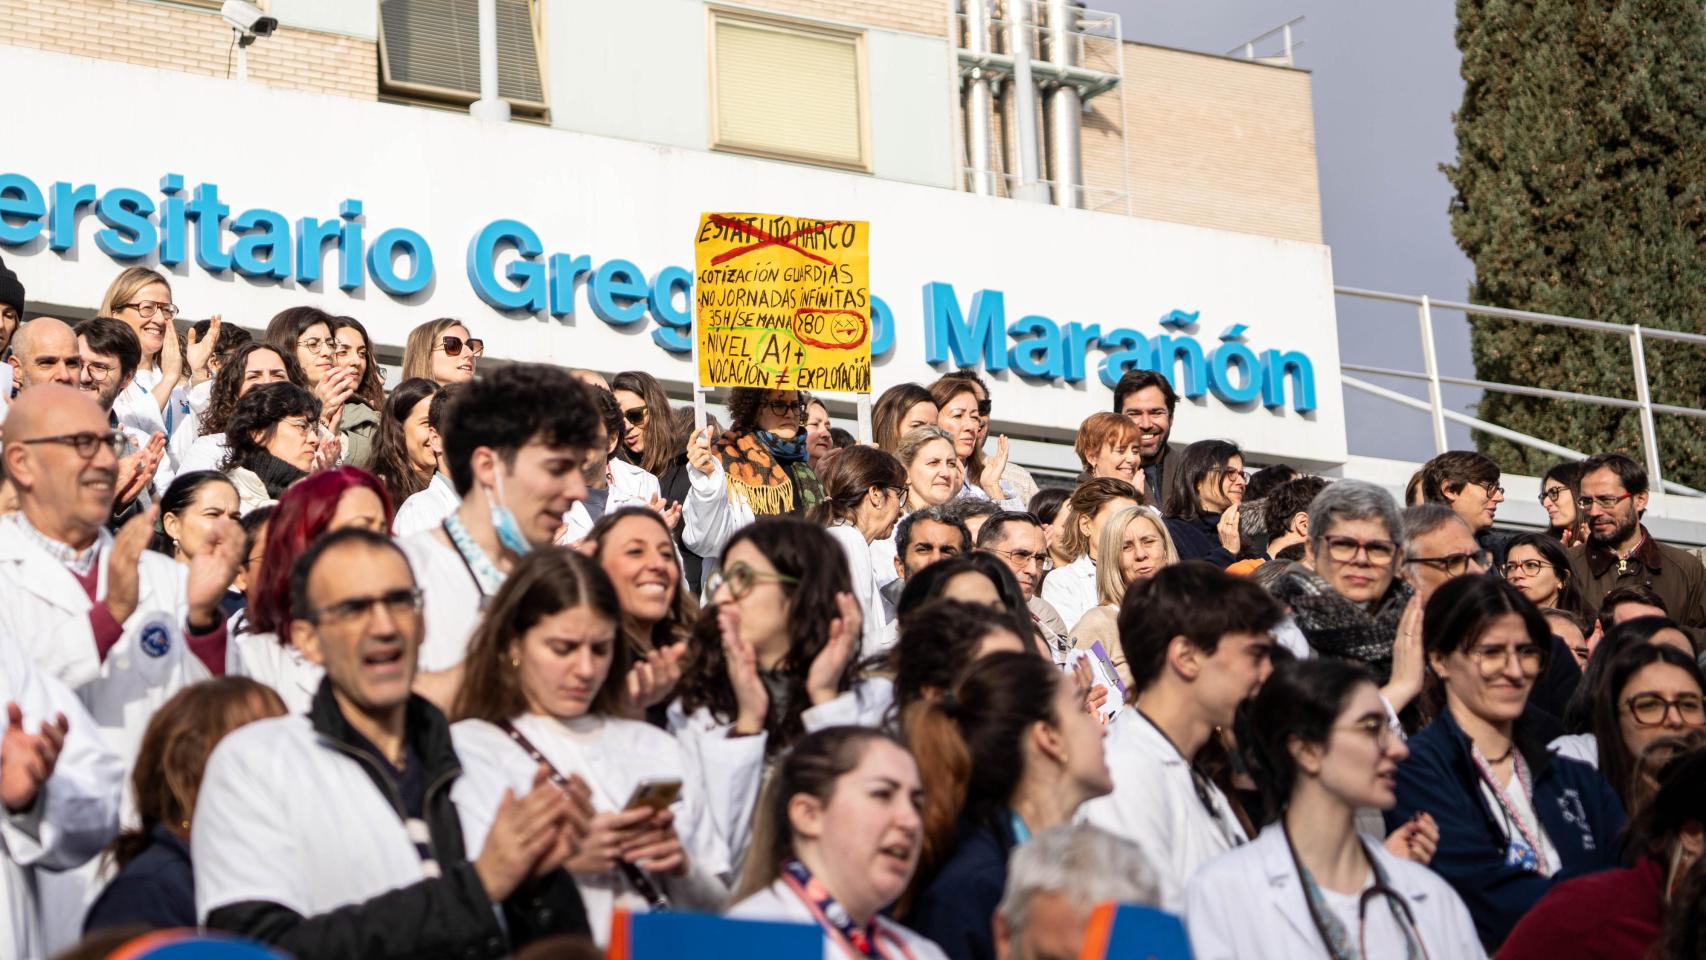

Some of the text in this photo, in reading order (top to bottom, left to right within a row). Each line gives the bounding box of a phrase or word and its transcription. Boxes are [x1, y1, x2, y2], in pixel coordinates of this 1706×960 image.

[699, 217, 856, 250] ESTATUTO MARCO
[701, 290, 714, 307] NO
[718, 286, 796, 309] JORNADAS
[922, 281, 1317, 413] Marañón
[707, 357, 769, 386] VOCACIÓN
[797, 357, 871, 391] EXPLOTACIÓN
